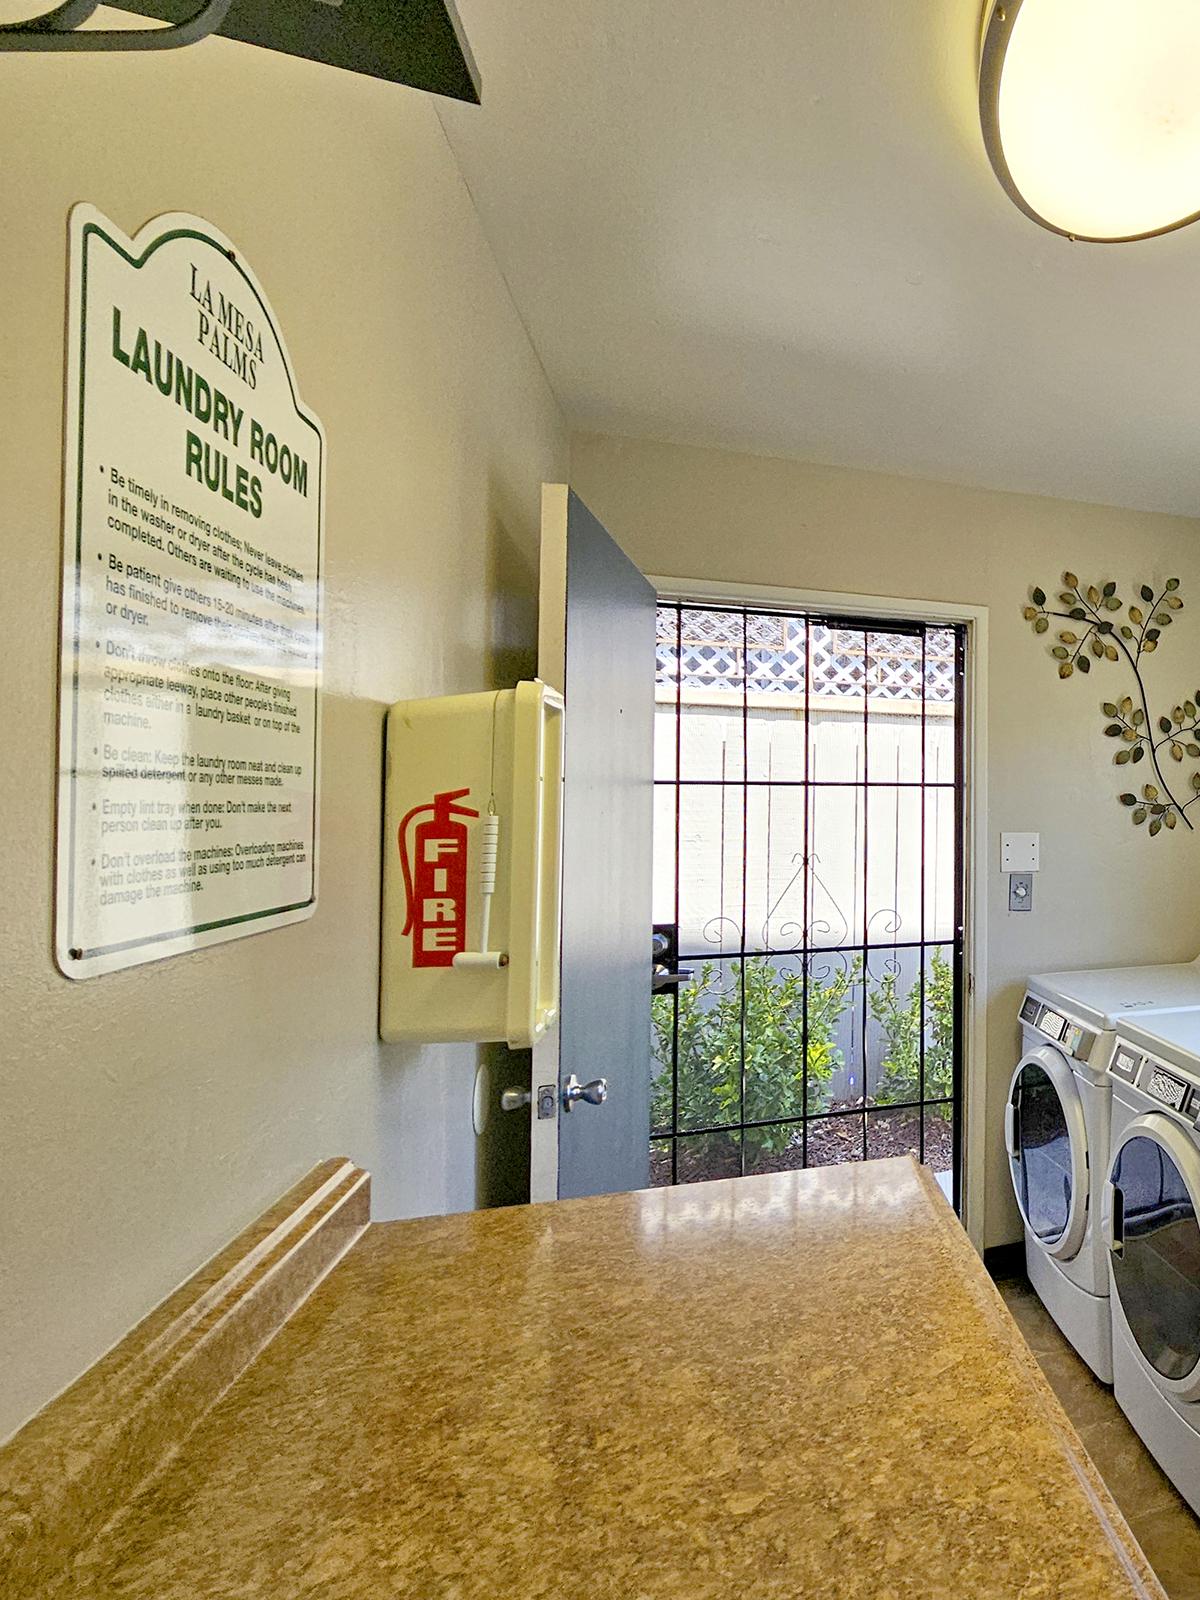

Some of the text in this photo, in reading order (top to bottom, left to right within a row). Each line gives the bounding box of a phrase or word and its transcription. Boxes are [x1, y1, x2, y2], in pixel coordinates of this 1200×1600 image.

[190, 263, 265, 364] LA MESA
[197, 310, 257, 390] PALMS
[112, 305, 308, 498] LAUNDRY ROOM
[186, 429, 263, 519] RULES
[107, 487, 118, 508] in
[120, 494, 138, 517] the
[140, 504, 175, 535] washer
[177, 526, 186, 541] or
[188, 528, 210, 556] dryer
[211, 541, 230, 563] after
[231, 551, 243, 569] the
[245, 559, 263, 582] cycle
[110, 466, 125, 489] Be
[127, 475, 158, 509] timely
[160, 493, 169, 512] in
[170, 499, 211, 537] removing
[243, 539, 263, 562] Never
[264, 550, 281, 571] leave
[106, 510, 165, 555] completed.
[167, 538, 197, 567] Others
[198, 556, 212, 573] are
[213, 561, 240, 589] waiting
[105, 574, 211, 627] has finished to remove
[108, 552, 123, 573] Be
[125, 559, 161, 591] patient
[163, 575, 182, 599] give
[183, 583, 211, 607] others
[212, 595, 233, 616] 15-20
[105, 601, 149, 629] or dryer.
[166, 676, 198, 699] leeway,
[200, 684, 222, 704] place
[222, 689, 243, 706] other
[244, 693, 272, 714] people's
[272, 700, 296, 717] finished
[201, 665, 220, 682] onto
[221, 669, 234, 685] the
[255, 678, 271, 695] After
[271, 683, 290, 702] giving
[103, 706, 151, 730] machine.
[185, 703, 191, 714] a
[194, 701, 224, 724] laundry
[225, 708, 250, 725] basket
[253, 716, 261, 727] or
[262, 717, 270, 728] on
[271, 718, 282, 733] top
[283, 719, 290, 732] of
[290, 720, 300, 733] the
[103, 744, 118, 760] Be
[154, 749, 179, 768] Keep
[181, 751, 194, 766] the
[196, 752, 226, 772] laundry
[226, 759, 246, 770] room
[247, 758, 263, 772] neat
[263, 760, 276, 773] and
[277, 761, 293, 774] clean
[294, 765, 302, 776] up
[188, 771, 197, 782] or
[198, 772, 213, 786] any
[214, 771, 235, 784] other
[236, 775, 262, 785] messes
[263, 774, 283, 786] made.
[101, 799, 136, 817] Empty
[178, 800, 200, 813] when
[202, 800, 224, 813] done:
[226, 800, 245, 813] Don't
[246, 801, 265, 813] make
[266, 801, 276, 812] the
[277, 802, 292, 813] next
[101, 819, 138, 835] person
[184, 817, 203, 829] after
[204, 818, 222, 831] you.
[98, 852, 306, 887] with clothes as well as using too much detergent can
[100, 852, 130, 869] Don't
[177, 847, 191, 862] the
[234, 840, 275, 858] Overloading
[276, 838, 303, 852] machines
[99, 877, 203, 909] damage the machine.
[422, 838, 459, 952] FIRE
